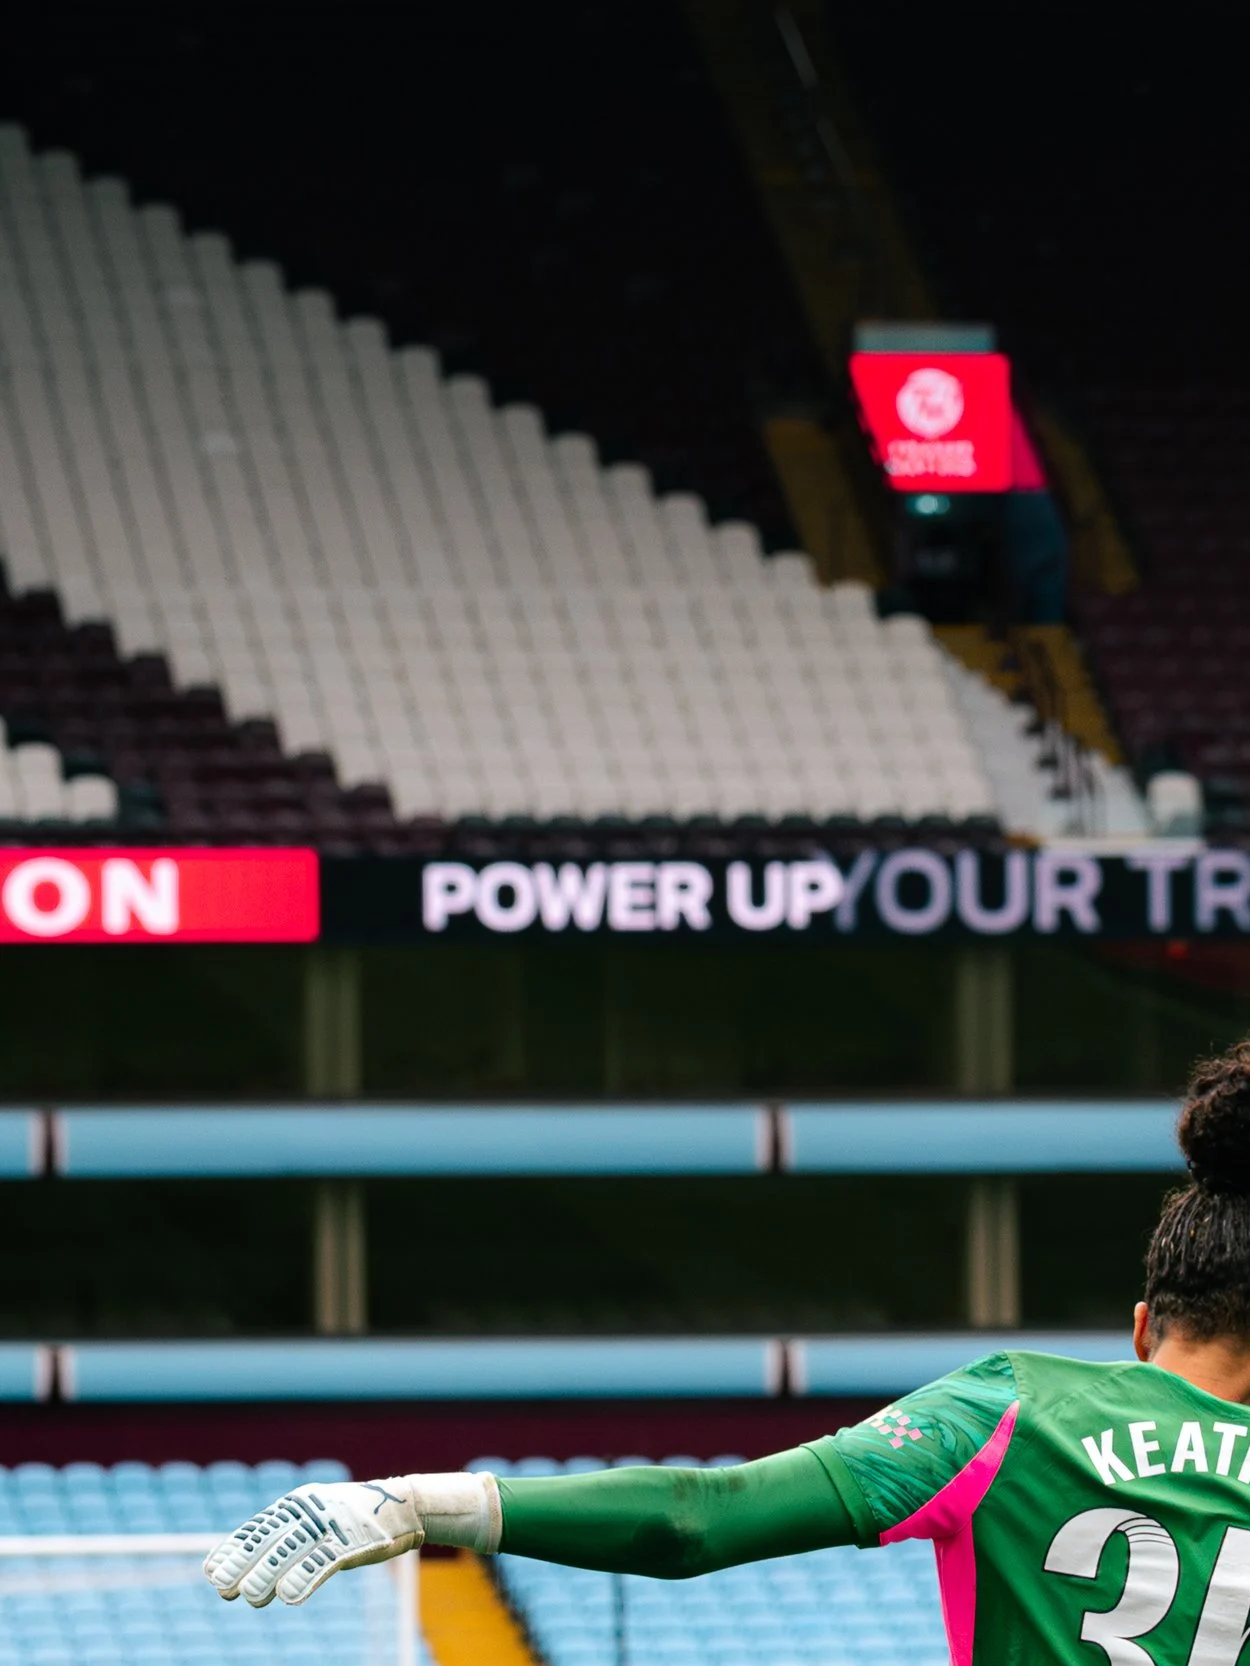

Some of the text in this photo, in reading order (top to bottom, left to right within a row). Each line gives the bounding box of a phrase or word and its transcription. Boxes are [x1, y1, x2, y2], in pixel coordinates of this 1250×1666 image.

[2, 858, 179, 935] ON
[423, 862, 713, 931] POWER
[726, 861, 842, 931] UP
[834, 848, 1102, 933] YOUR
